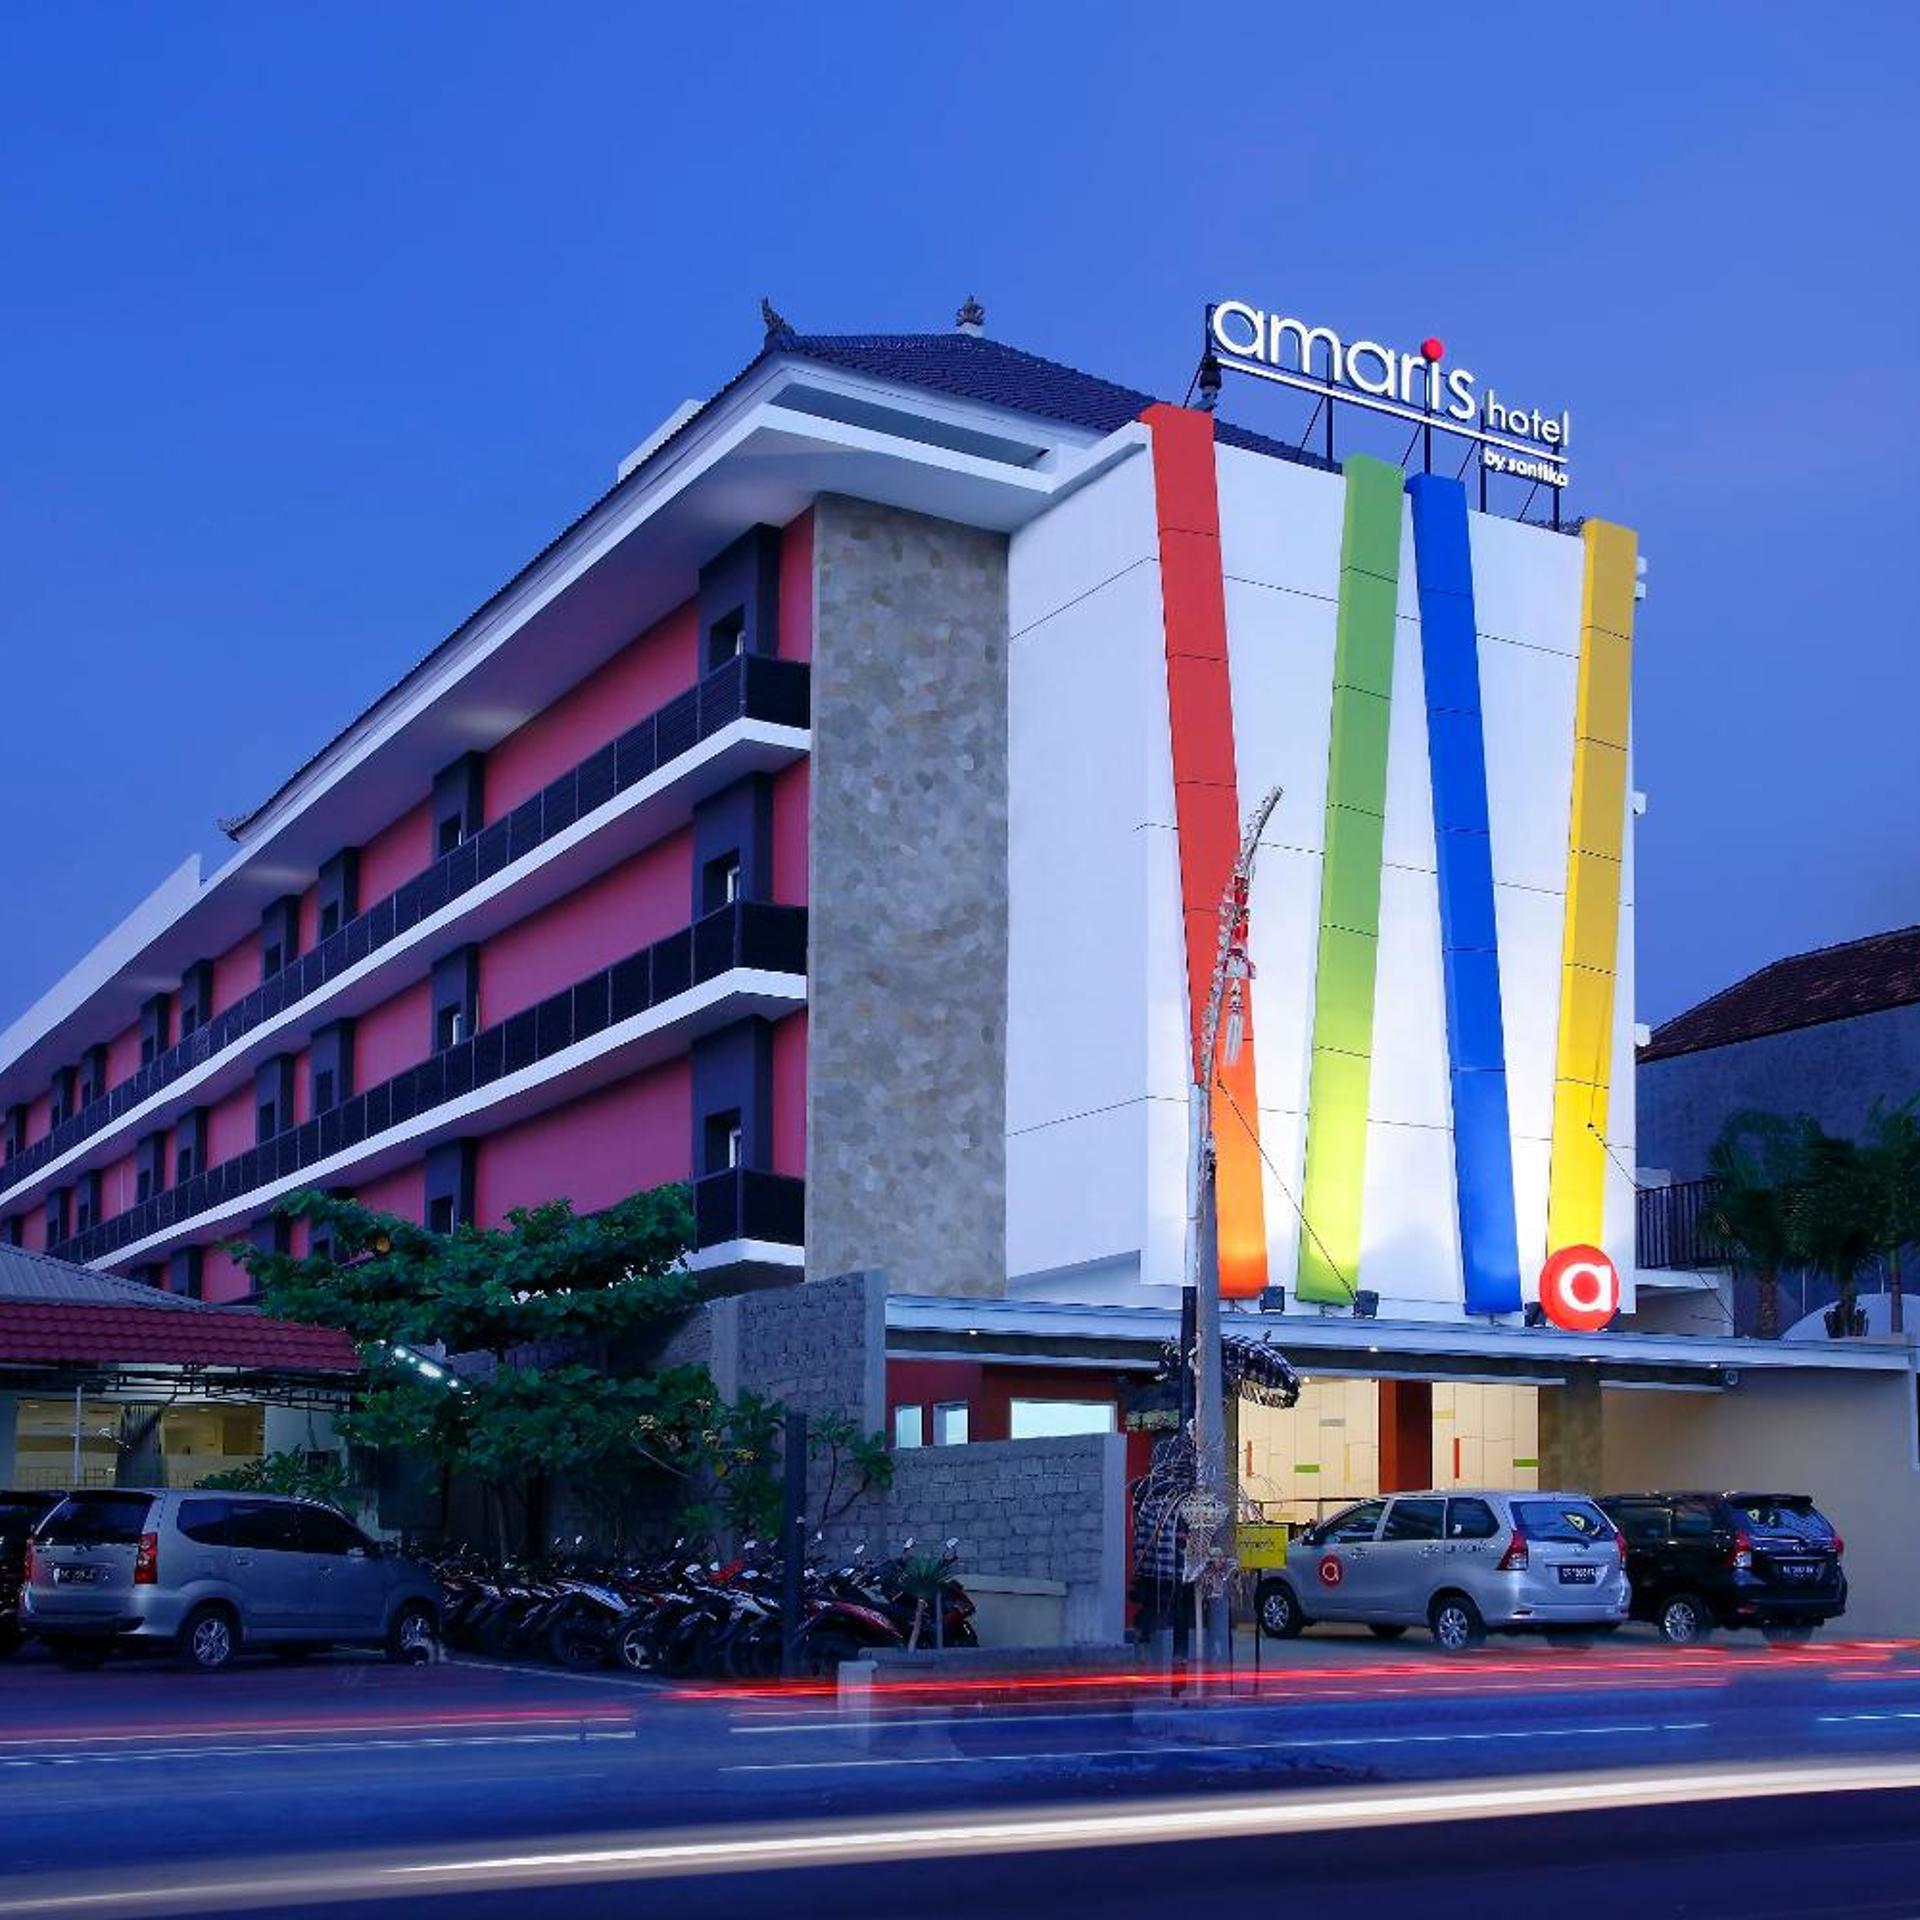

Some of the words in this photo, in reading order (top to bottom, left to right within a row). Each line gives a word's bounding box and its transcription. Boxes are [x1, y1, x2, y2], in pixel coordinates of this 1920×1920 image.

[1213, 300, 1476, 420] amaris
[1488, 388, 1569, 446] hotel
[1484, 447, 1506, 472] by
[1507, 458, 1568, 487] santika
[1559, 1263, 1612, 1312] a
